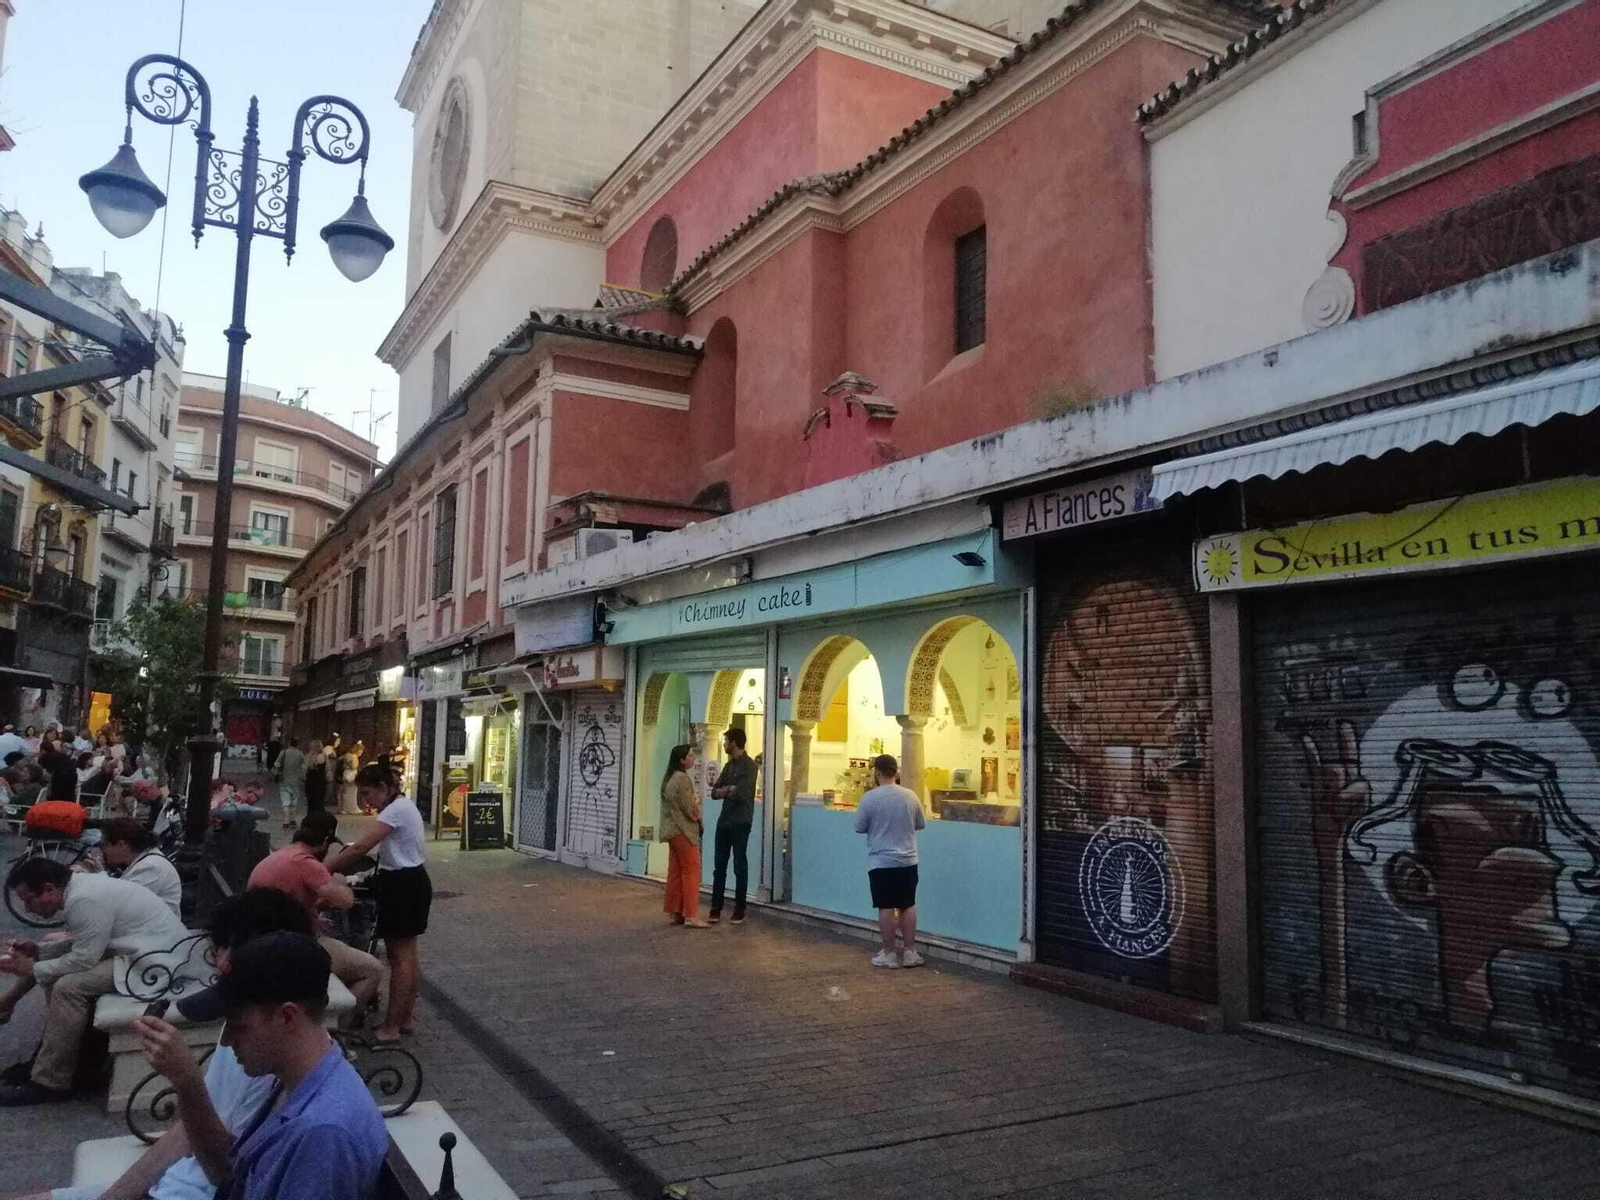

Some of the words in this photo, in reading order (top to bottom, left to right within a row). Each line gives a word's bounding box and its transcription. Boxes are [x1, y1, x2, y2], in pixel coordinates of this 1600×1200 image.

[1253, 536, 1386, 575] Sevilla
[1402, 536, 1449, 558] en
[1468, 524, 1539, 551] tus
[758, 585, 802, 612] cake
[748, 702, 755, 711] 6
